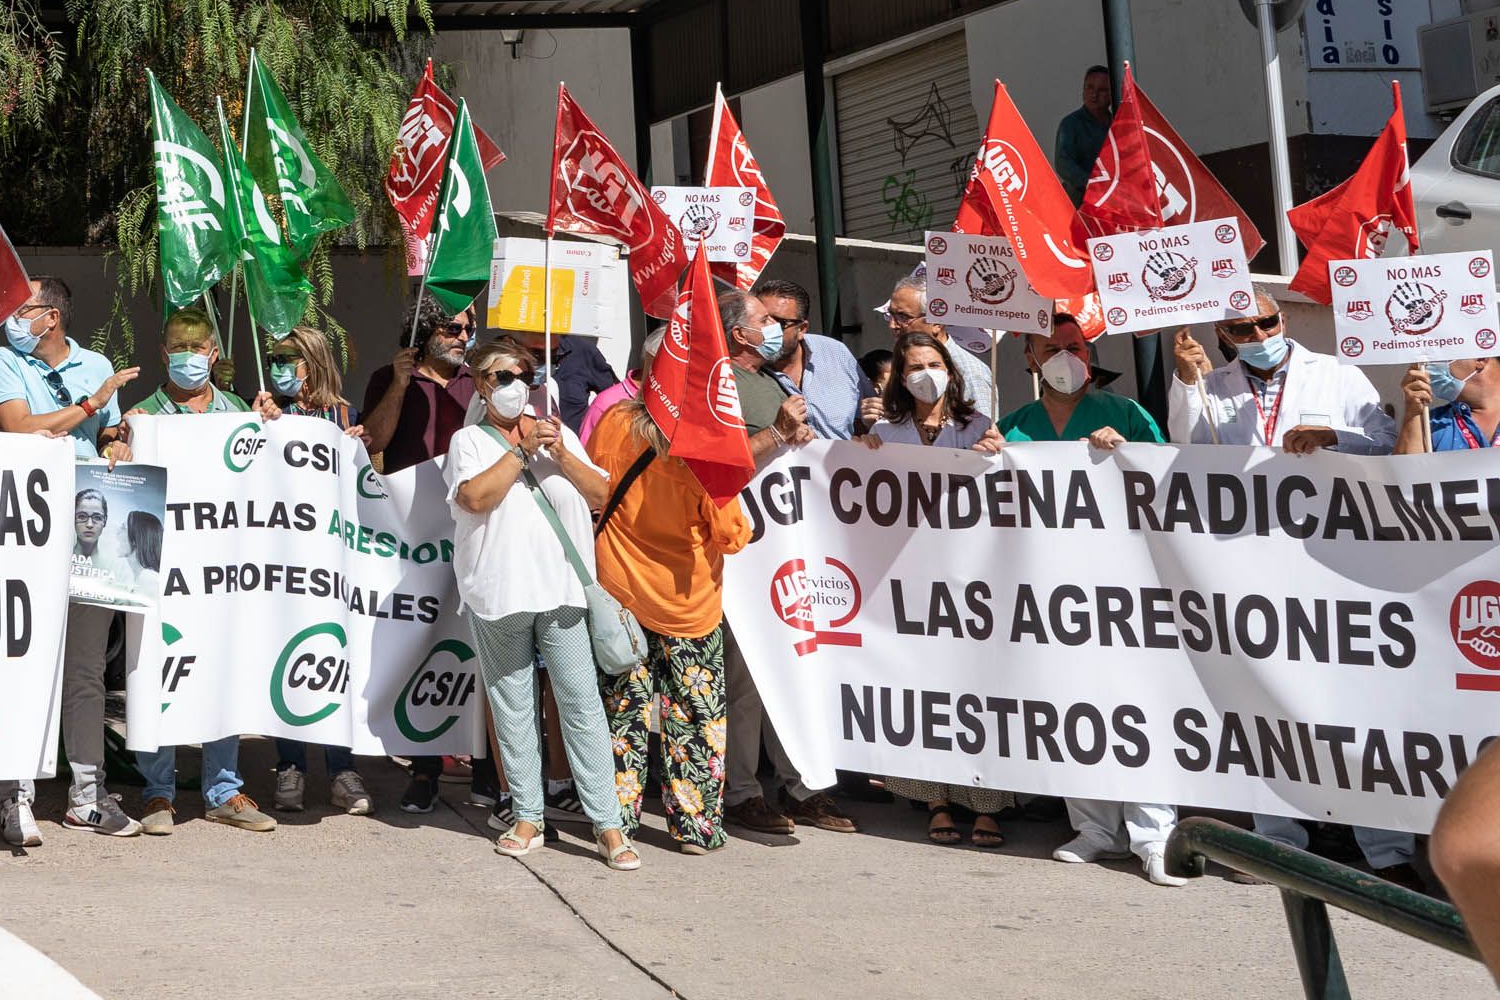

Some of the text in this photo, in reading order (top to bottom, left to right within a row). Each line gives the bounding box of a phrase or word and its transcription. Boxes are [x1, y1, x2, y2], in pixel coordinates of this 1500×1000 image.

[984, 145, 1024, 193] UGT
[685, 194, 721, 203] NO MAS
[968, 244, 1014, 258] NO MAS
[1138, 234, 1190, 252] NO MAS
[937, 267, 956, 279] UGT
[1212, 258, 1235, 271] UGT
[1387, 265, 1442, 281] NO MAS
[581, 270, 591, 296] Canon
[1108, 272, 1129, 284] UGT
[1148, 256, 1199, 303] AGRESIONES
[1134, 299, 1220, 318] Pedimos respeto
[1346, 300, 1372, 313] UGT
[1460, 294, 1485, 307] UGT
[954, 303, 993, 316] Pedimos
[995, 307, 1030, 320] respeto
[1390, 289, 1449, 336] AGRESIONES
[1372, 336, 1465, 350] Pedimos respeto
[233, 438, 267, 456] CSIF
[283, 440, 341, 477] CSI
[829, 466, 1106, 531] CONDENA
[166, 501, 239, 532] TRA
[247, 500, 317, 532] LAS
[163, 567, 191, 597] A
[1459, 595, 1500, 630] UG
[890, 578, 1416, 669] LAS AGRESIONES
[840, 683, 1150, 768] NUESTROS
